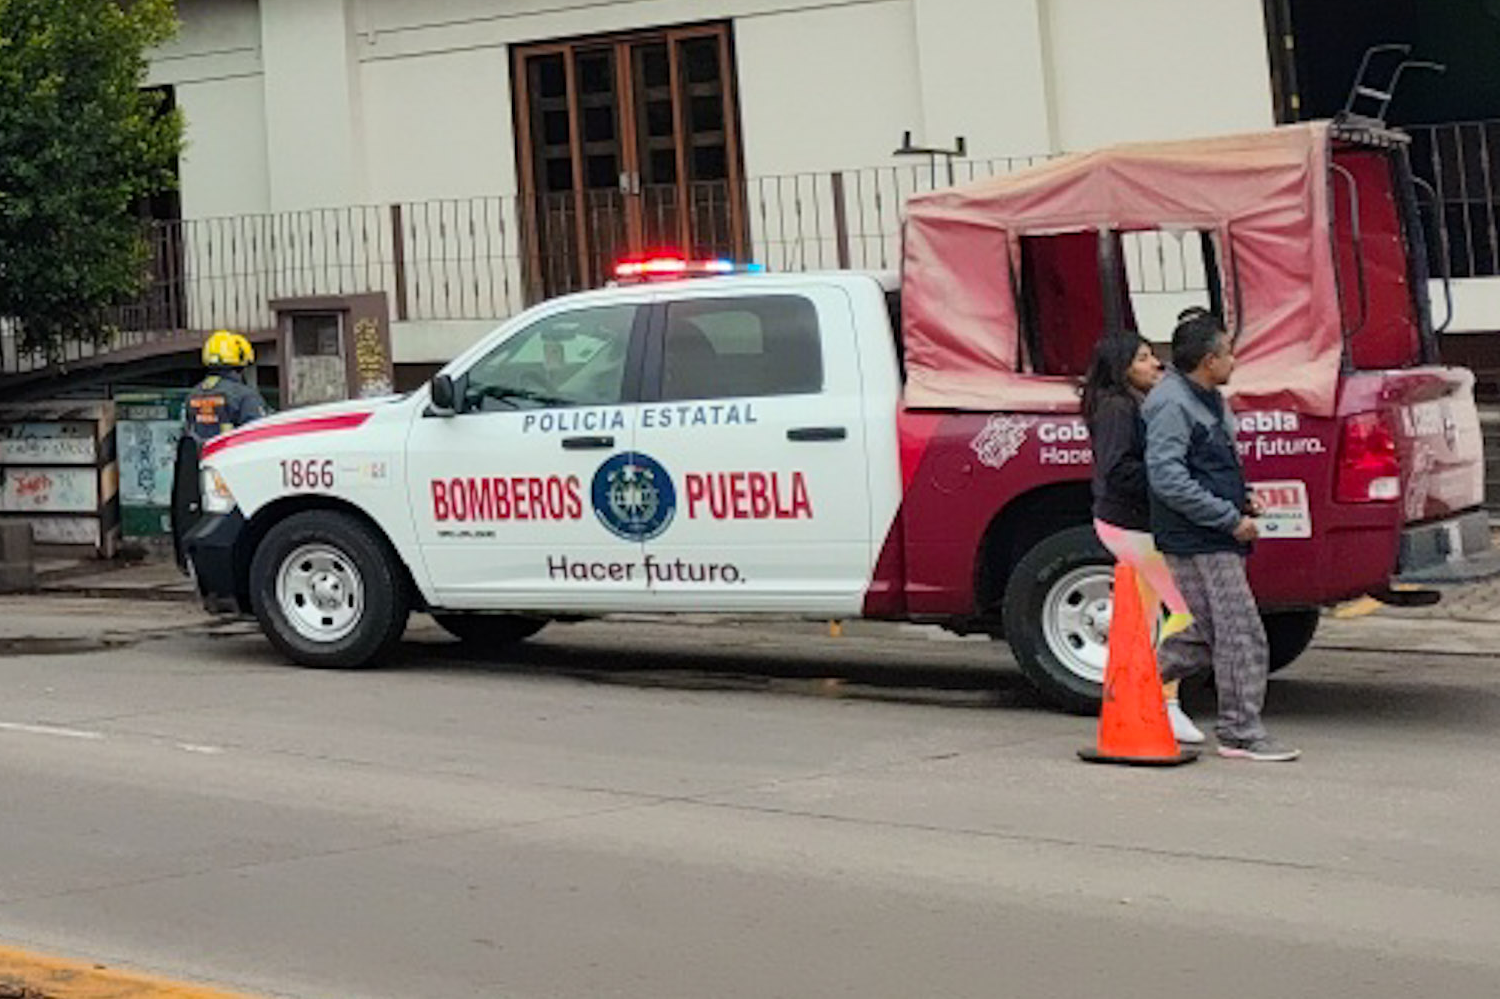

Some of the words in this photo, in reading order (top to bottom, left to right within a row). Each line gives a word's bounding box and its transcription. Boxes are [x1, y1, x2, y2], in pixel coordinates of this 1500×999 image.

[521, 410, 626, 434] POLICIA
[641, 404, 759, 429] ESTATAL
[1236, 410, 1298, 432] ebla
[1256, 435, 1327, 461] futuro.
[280, 459, 335, 489] 1866
[431, 474, 583, 523] BOMBEROS
[685, 471, 814, 521] PUEBLA
[547, 555, 636, 582] Hacer
[642, 554, 747, 589] futuro.
